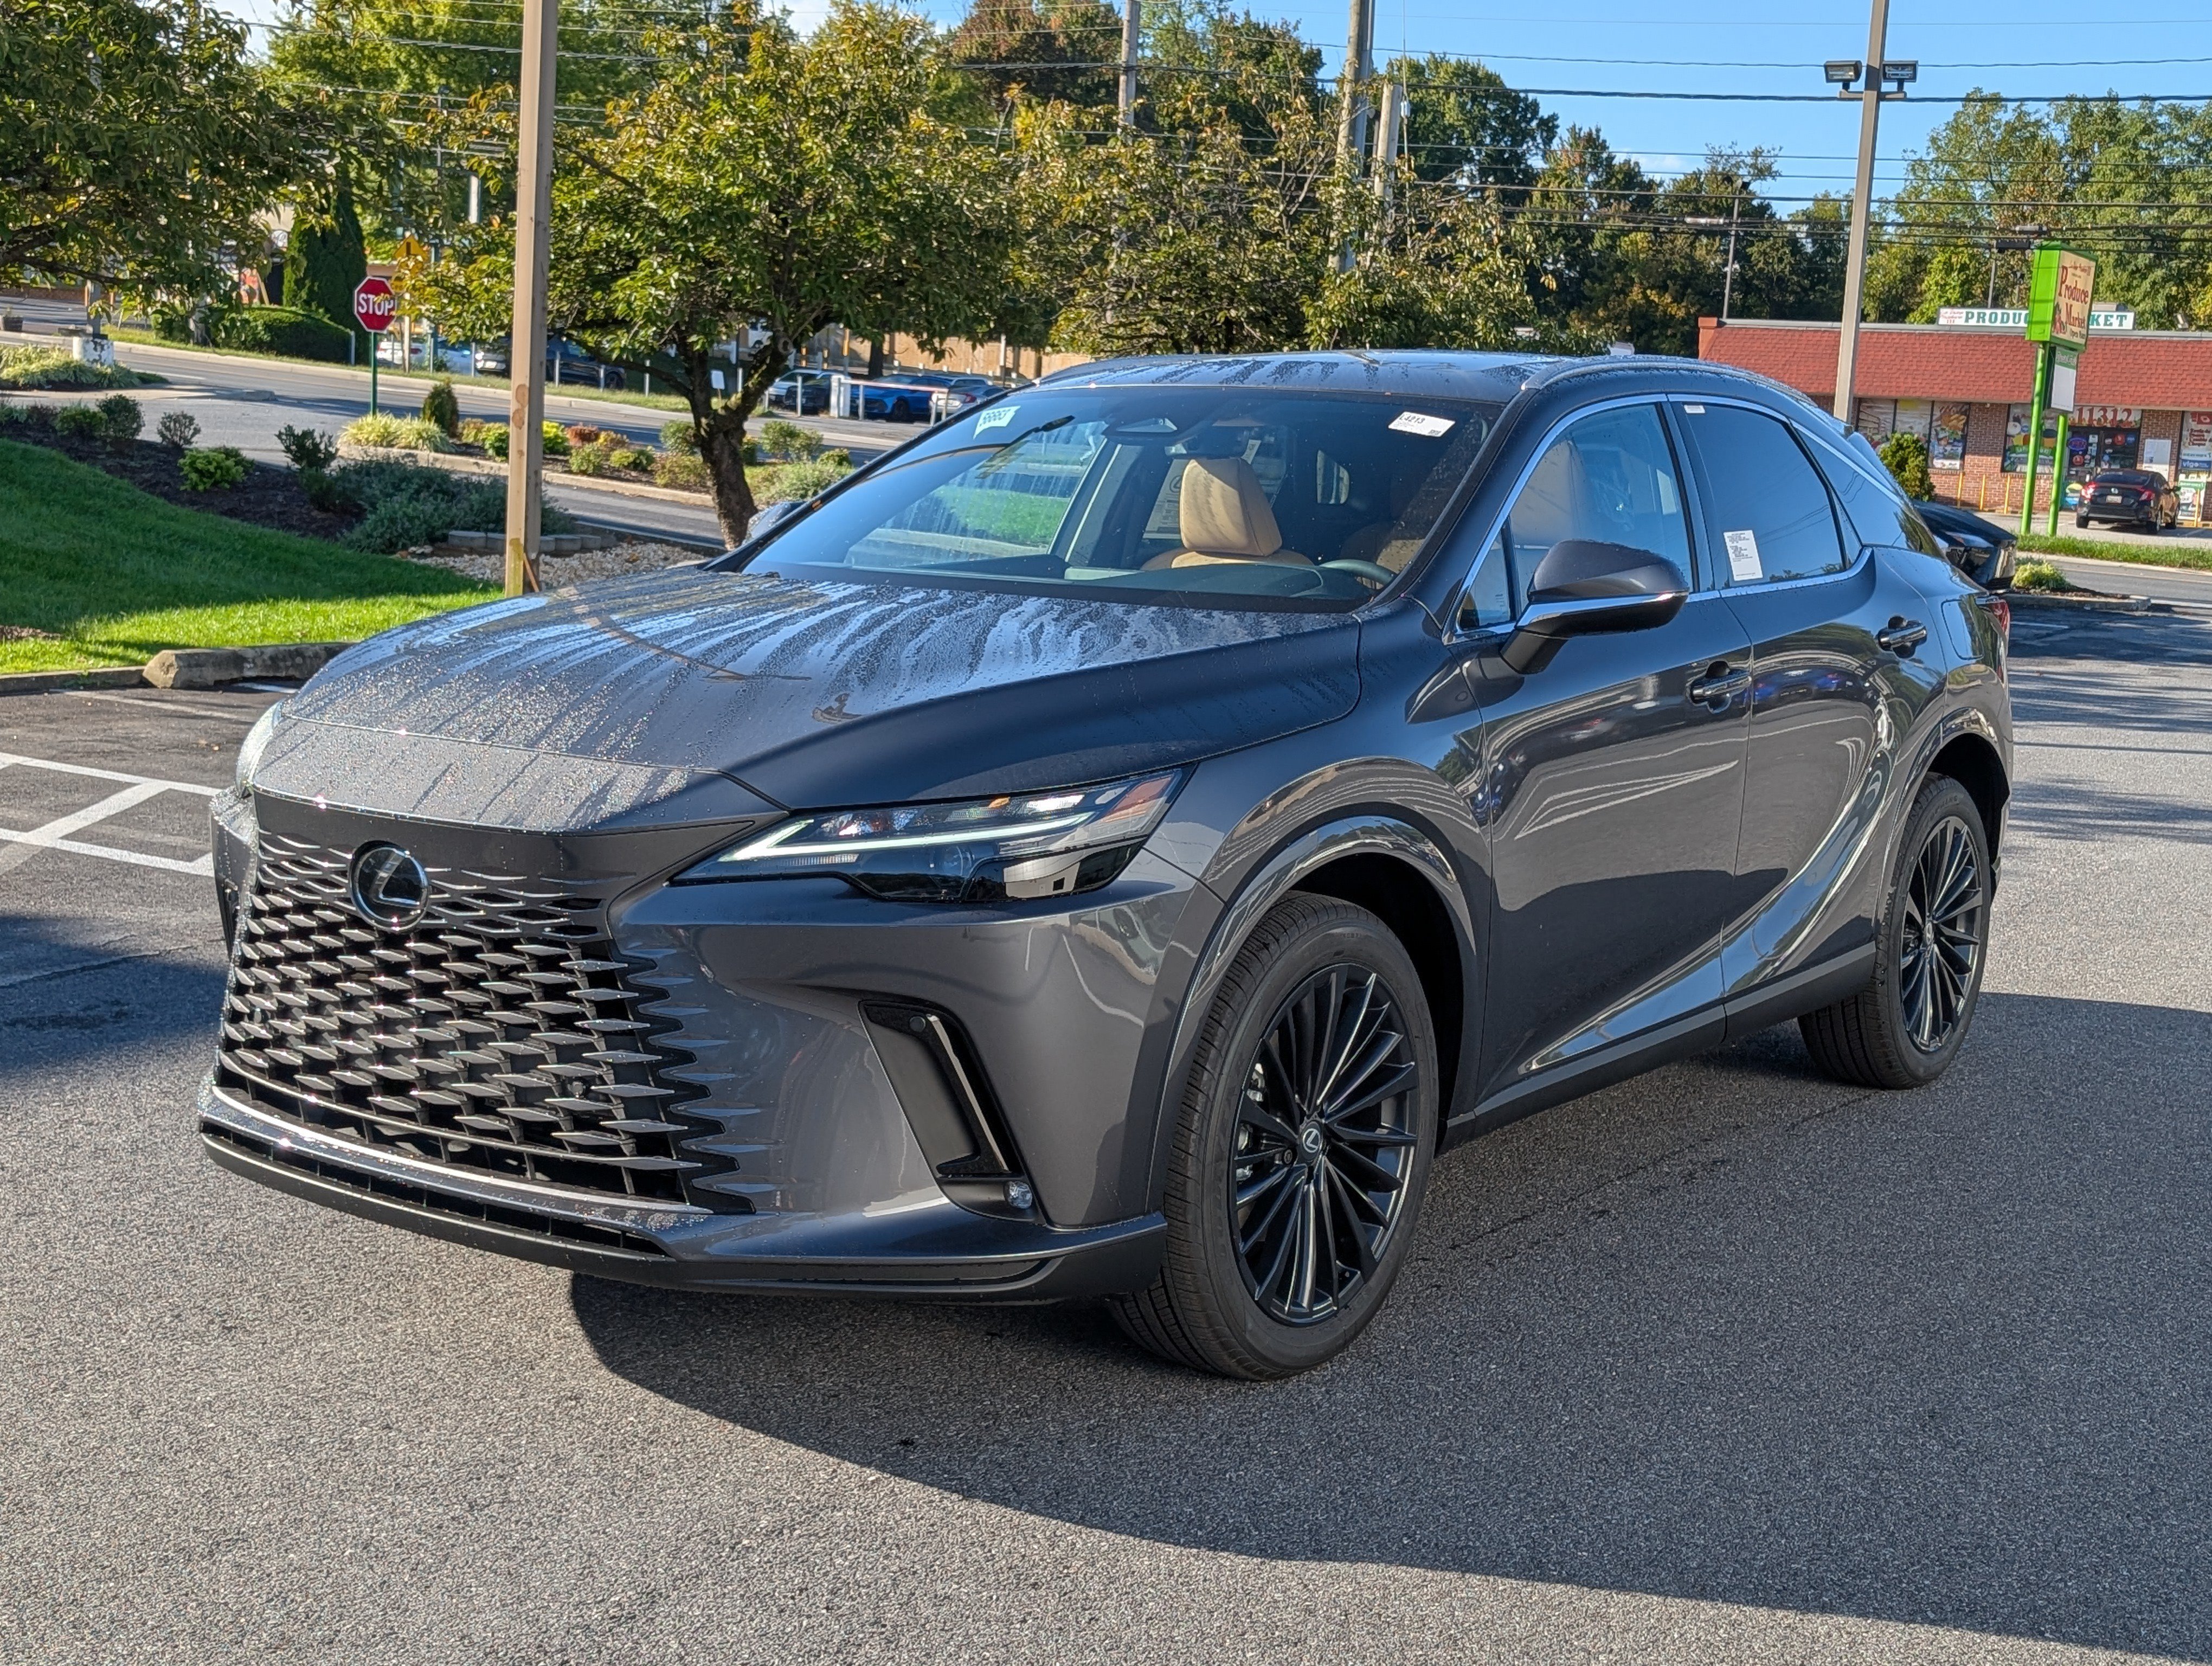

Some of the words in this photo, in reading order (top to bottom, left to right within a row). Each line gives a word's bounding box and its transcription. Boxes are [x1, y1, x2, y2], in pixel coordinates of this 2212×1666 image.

[2058, 265, 2089, 305] Produce
[358, 293, 394, 316] STOP
[2065, 302, 2086, 329] Market
[2076, 406, 2132, 428] 11312
